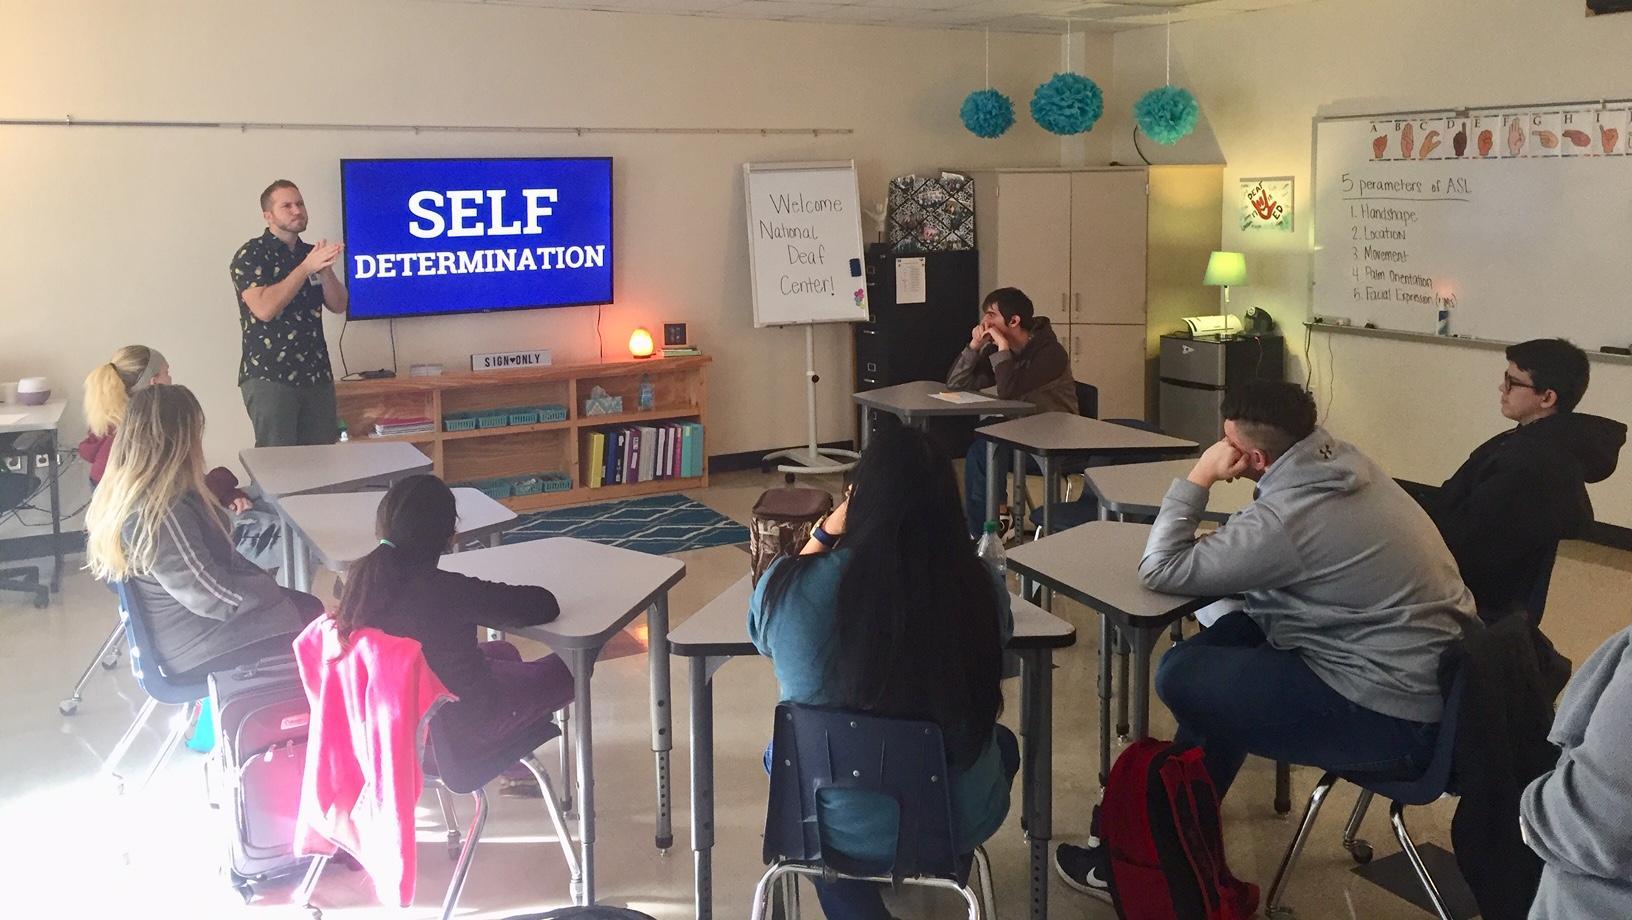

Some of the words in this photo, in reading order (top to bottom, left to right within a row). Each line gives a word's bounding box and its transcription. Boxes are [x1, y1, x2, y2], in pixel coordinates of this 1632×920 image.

[1369, 124, 1378, 133] A
[1394, 122, 1401, 132] B
[1419, 121, 1428, 131] C
[1446, 119, 1455, 129] D
[1474, 118, 1481, 128] E
[1532, 115, 1542, 126] G
[1564, 114, 1573, 124] H
[1341, 173, 1354, 192] 5
[1359, 178, 1422, 197] perameters
[1431, 179, 1441, 192] of
[1446, 177, 1472, 194] ASL
[408, 188, 558, 239] SELF
[769, 192, 843, 214] Welcome
[1360, 203, 1418, 226] Handshape
[759, 219, 818, 240] National
[1364, 226, 1406, 241] Location
[354, 245, 606, 279] DETERMINATION
[787, 244, 825, 265] Deaf
[1364, 245, 1409, 263] Movement
[780, 274, 835, 296] Center!
[1364, 265, 1386, 281] Palm
[1388, 269, 1434, 289] Orientation
[1364, 286, 1392, 302] Facial
[484, 355, 510, 368] SIGN
[515, 353, 541, 366] ONLY
